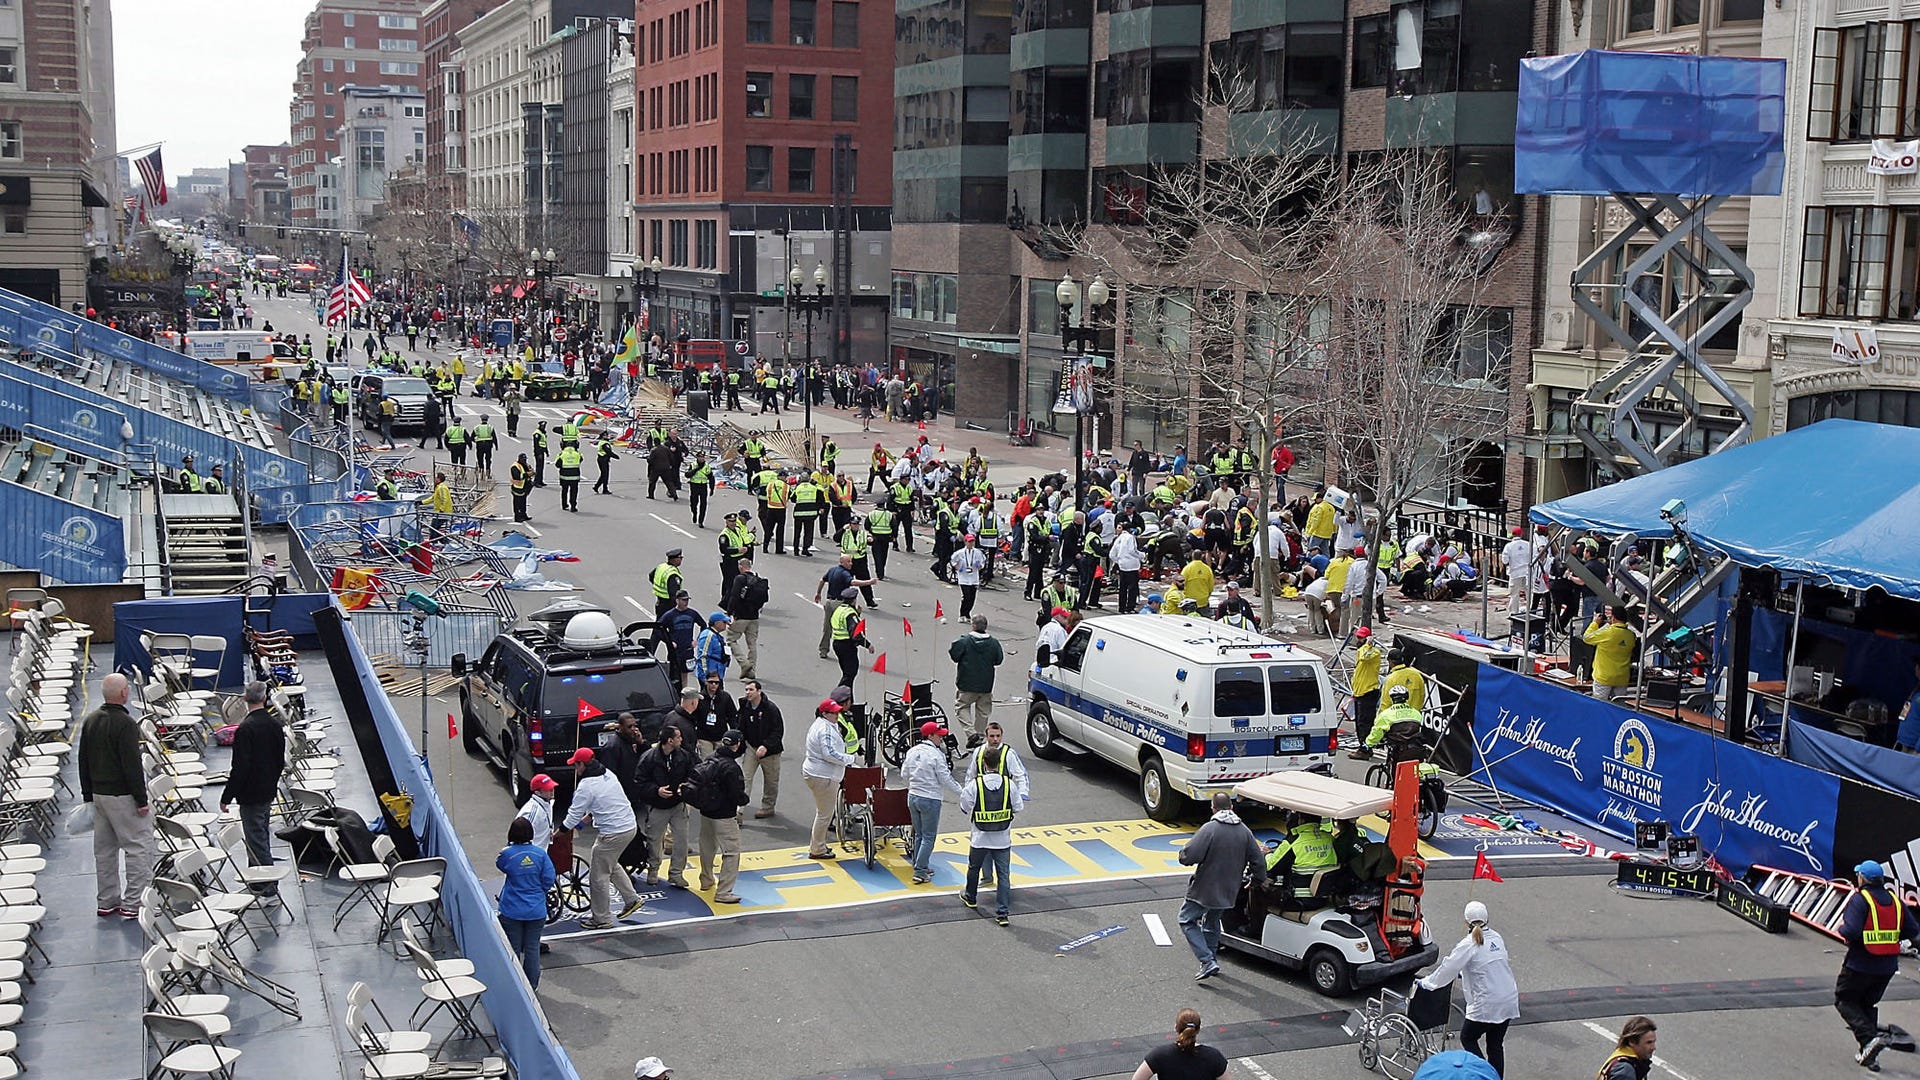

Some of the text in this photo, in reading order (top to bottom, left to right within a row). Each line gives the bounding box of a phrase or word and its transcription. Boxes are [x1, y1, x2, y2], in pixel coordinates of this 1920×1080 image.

[118, 292, 155, 302] LENOX
[1103, 709, 1167, 746] Boston Police
[1272, 724, 1300, 732] POLICE
[1481, 706, 1584, 782] John Hancock
[1603, 774, 1661, 807] MARATHON
[1621, 768, 1662, 793] BOSTON
[1681, 778, 1822, 872] John Hancock
[1636, 868, 1711, 891] 4:15:41
[1650, 886, 1673, 895] BOSTON
[1728, 891, 1770, 925] 4:15:41
